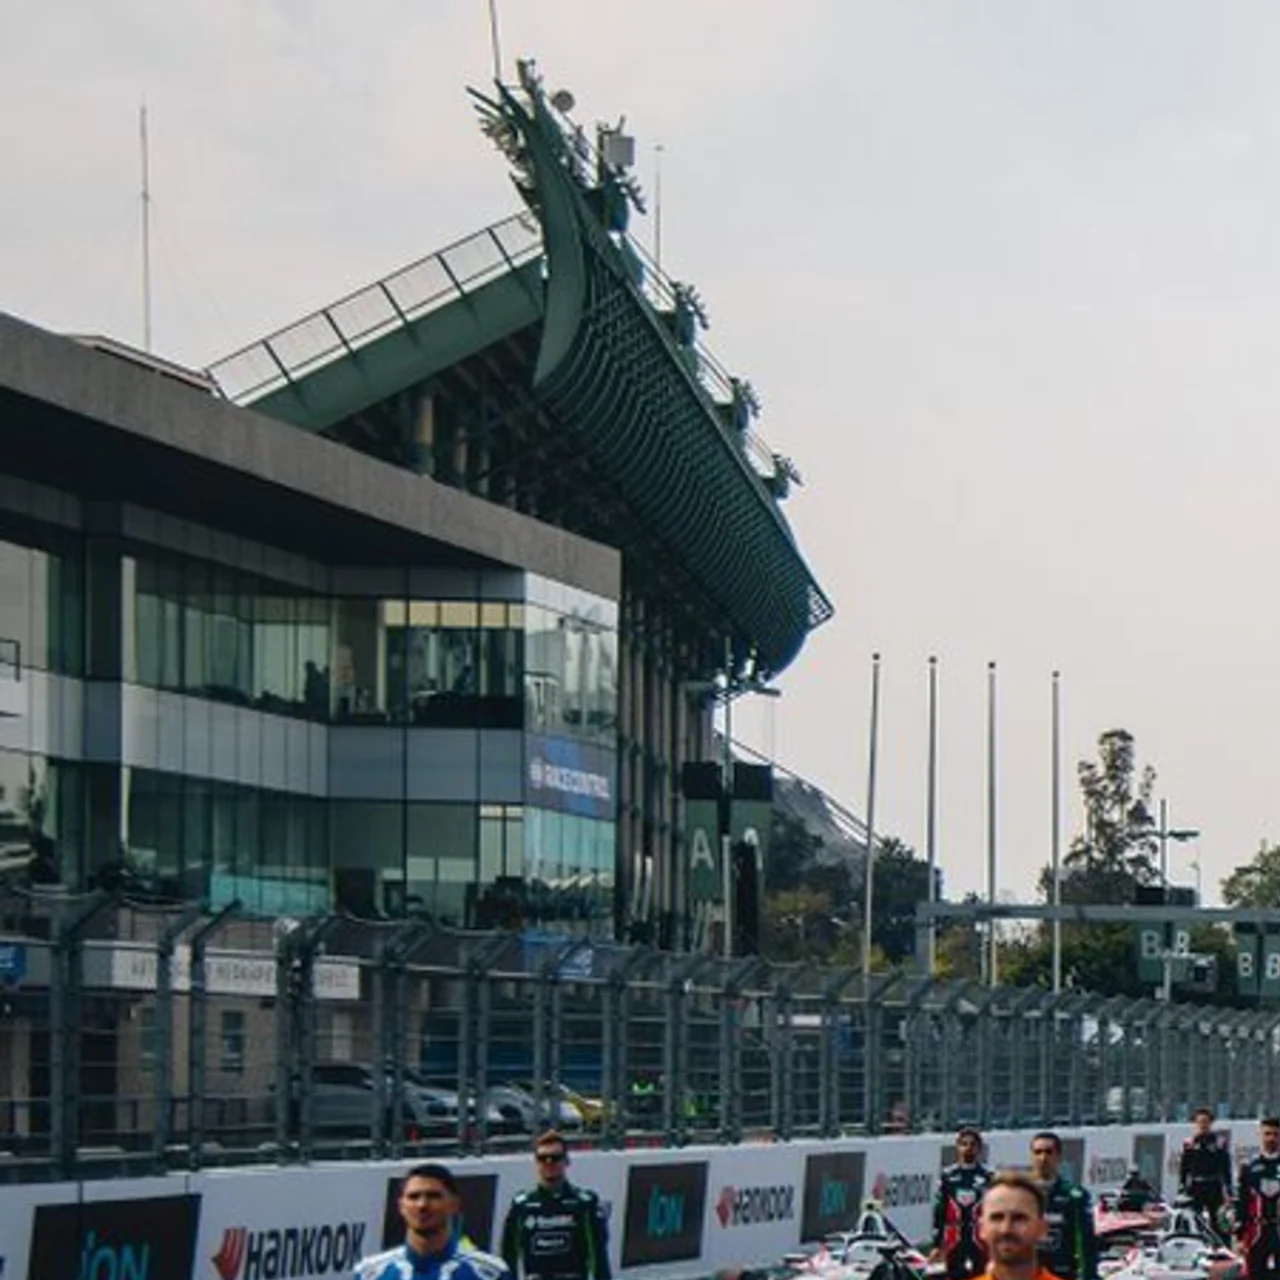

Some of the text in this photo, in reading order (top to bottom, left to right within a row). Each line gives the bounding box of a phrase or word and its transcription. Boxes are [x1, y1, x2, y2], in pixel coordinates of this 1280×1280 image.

[691, 827, 715, 870] A
[1141, 930, 1161, 957] B
[1238, 952, 1252, 977] B
